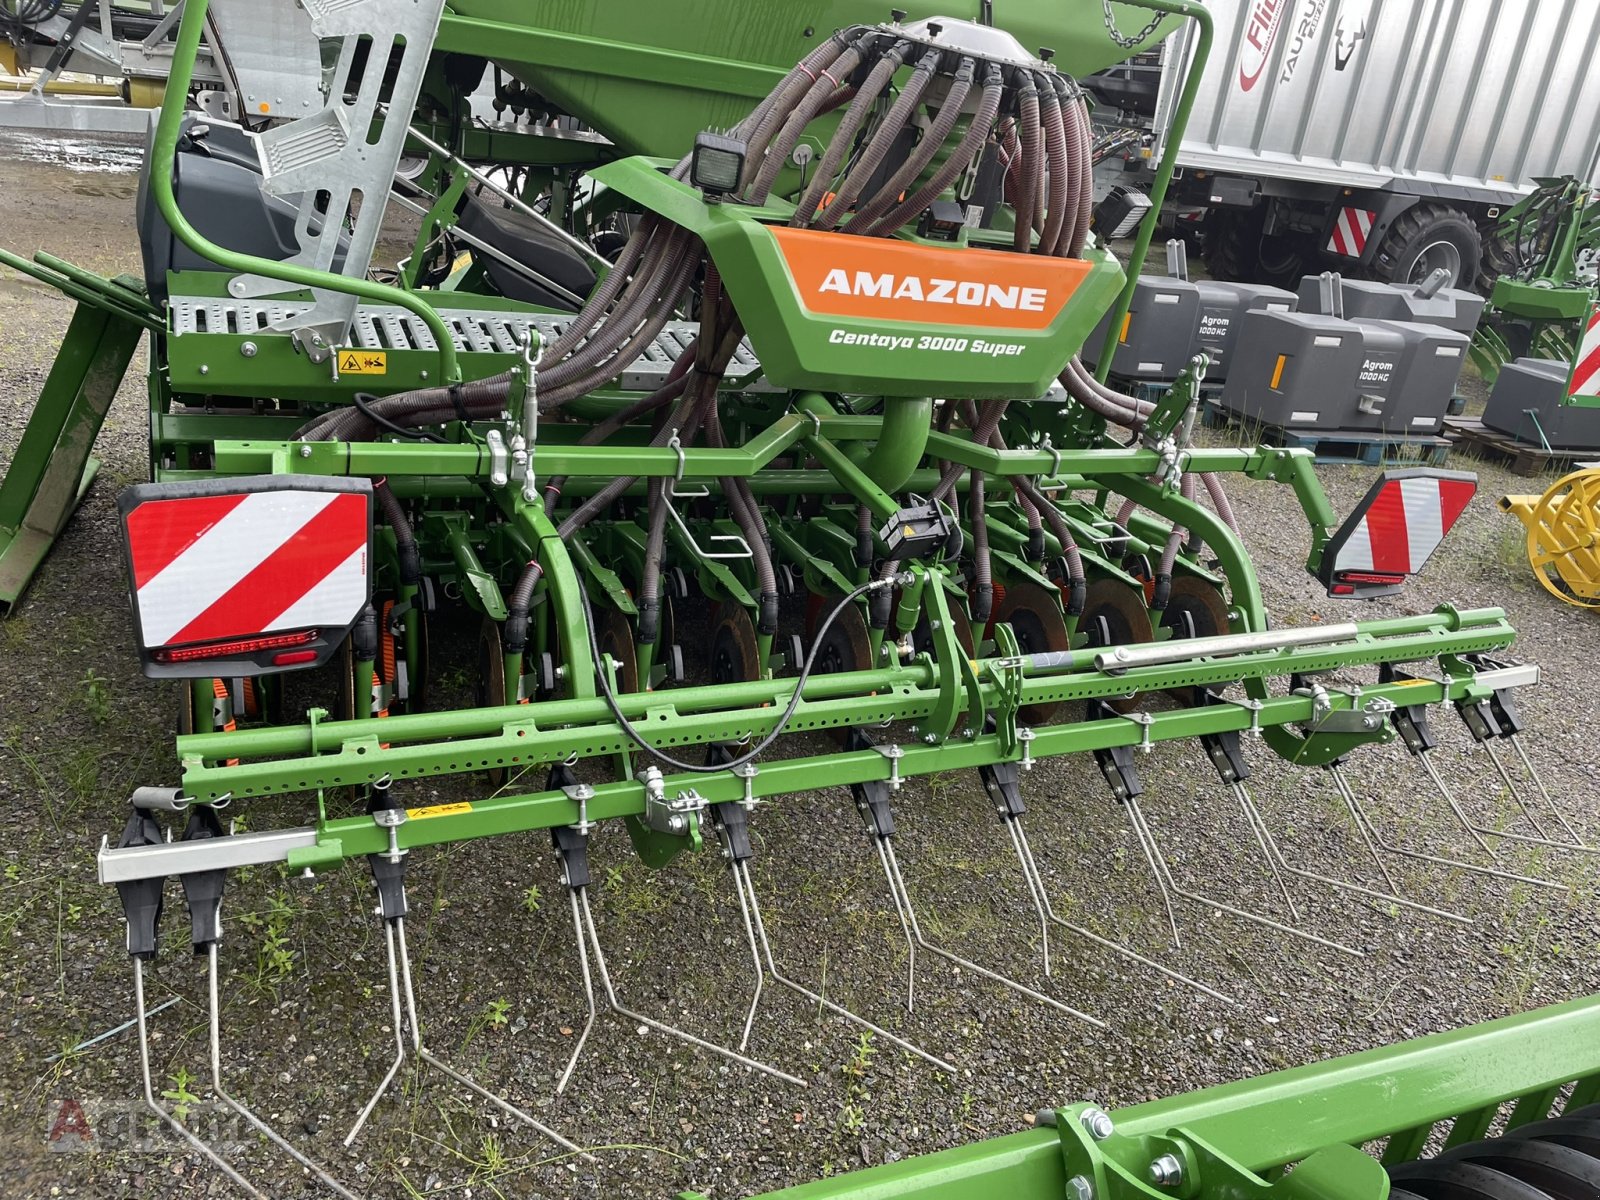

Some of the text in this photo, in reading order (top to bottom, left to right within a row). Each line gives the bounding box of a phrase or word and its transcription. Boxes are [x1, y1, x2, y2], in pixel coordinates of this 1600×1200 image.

[819, 268, 1048, 312] AMAZONE
[1201, 315, 1230, 326] Agrom
[1199, 326, 1216, 335] 1000
[829, 329, 1026, 357] Centaya 3000 Super
[1362, 359, 1393, 371] Agrom
[1359, 371, 1378, 381] 1000
